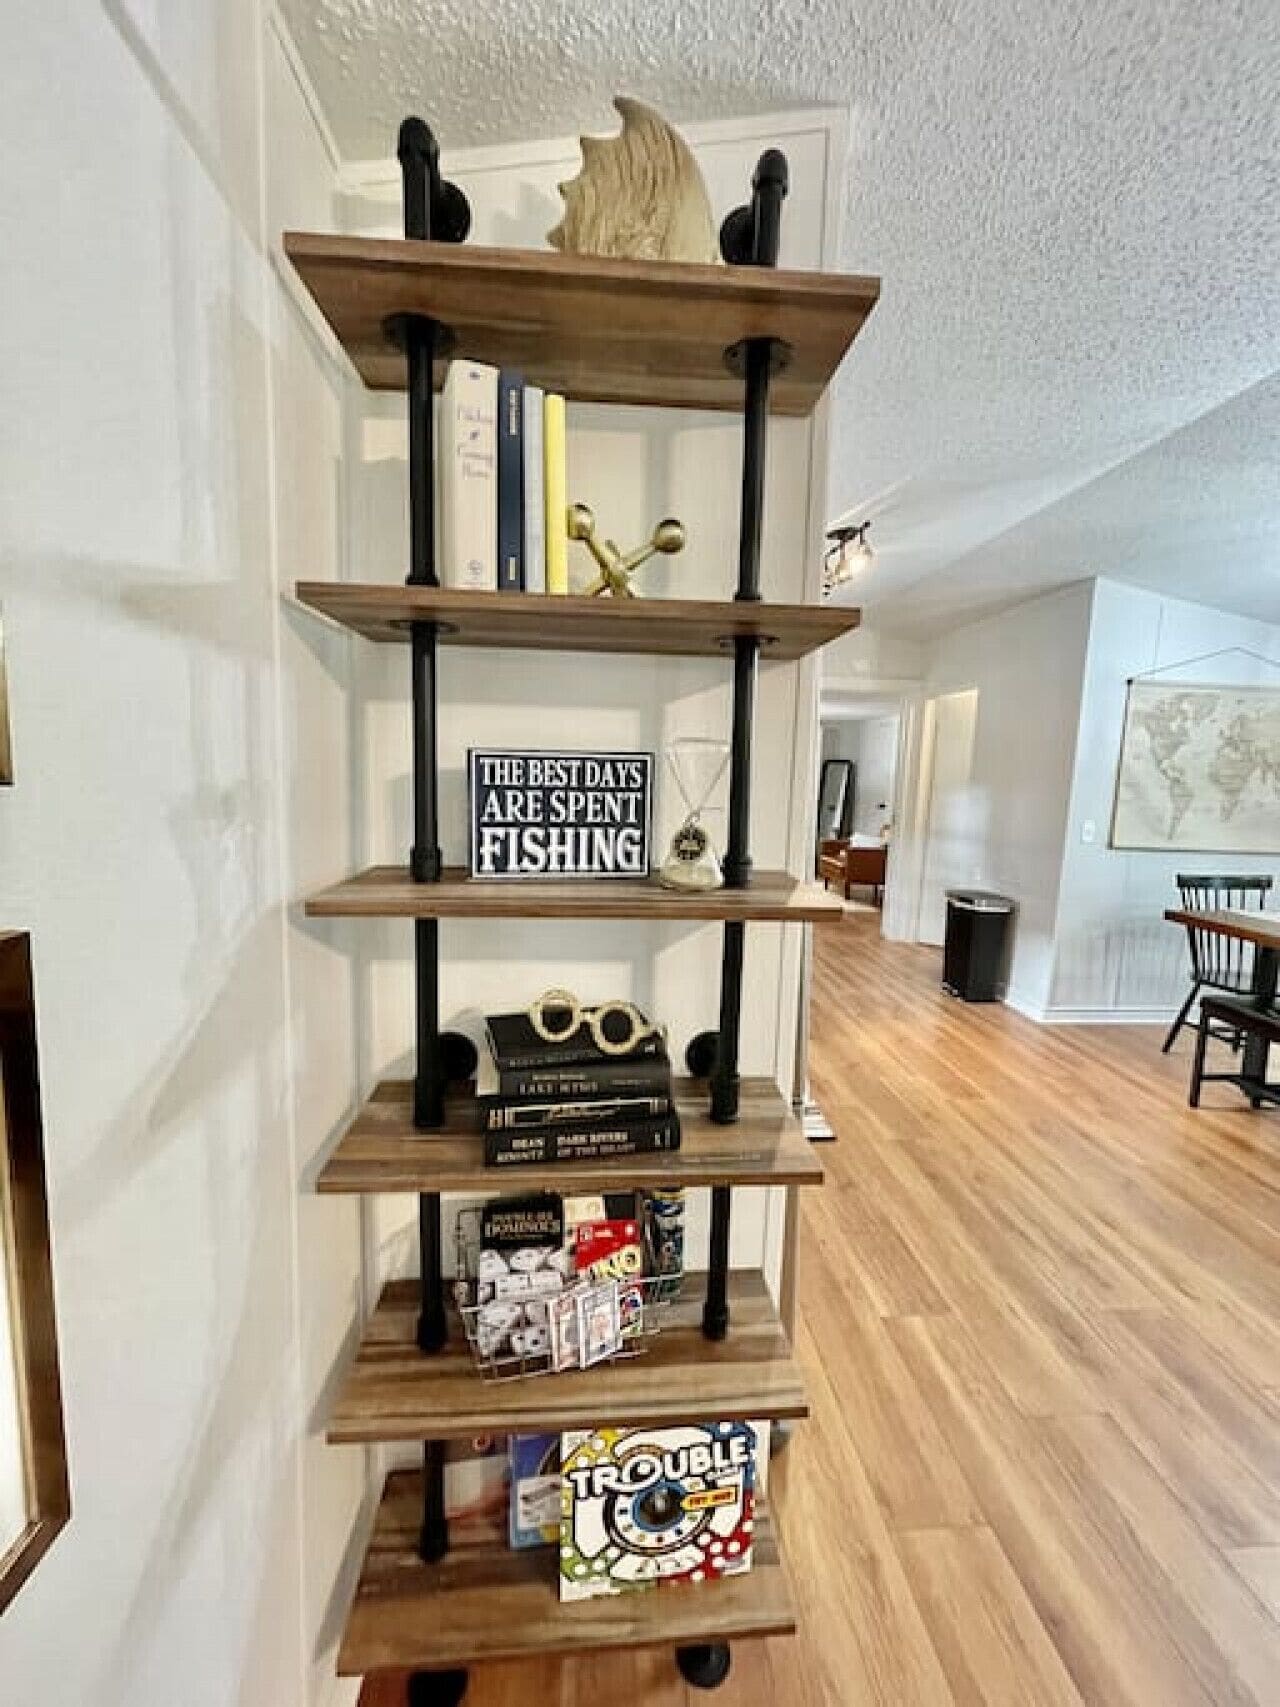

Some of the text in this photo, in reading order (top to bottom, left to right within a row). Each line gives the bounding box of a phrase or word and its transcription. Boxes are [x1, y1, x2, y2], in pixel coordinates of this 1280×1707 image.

[480, 758, 641, 788] THE BEST DAYS
[480, 789, 641, 823] ARE SPENT
[480, 827, 641, 871] FISHING
[570, 1435, 749, 1498] TROUBLE
